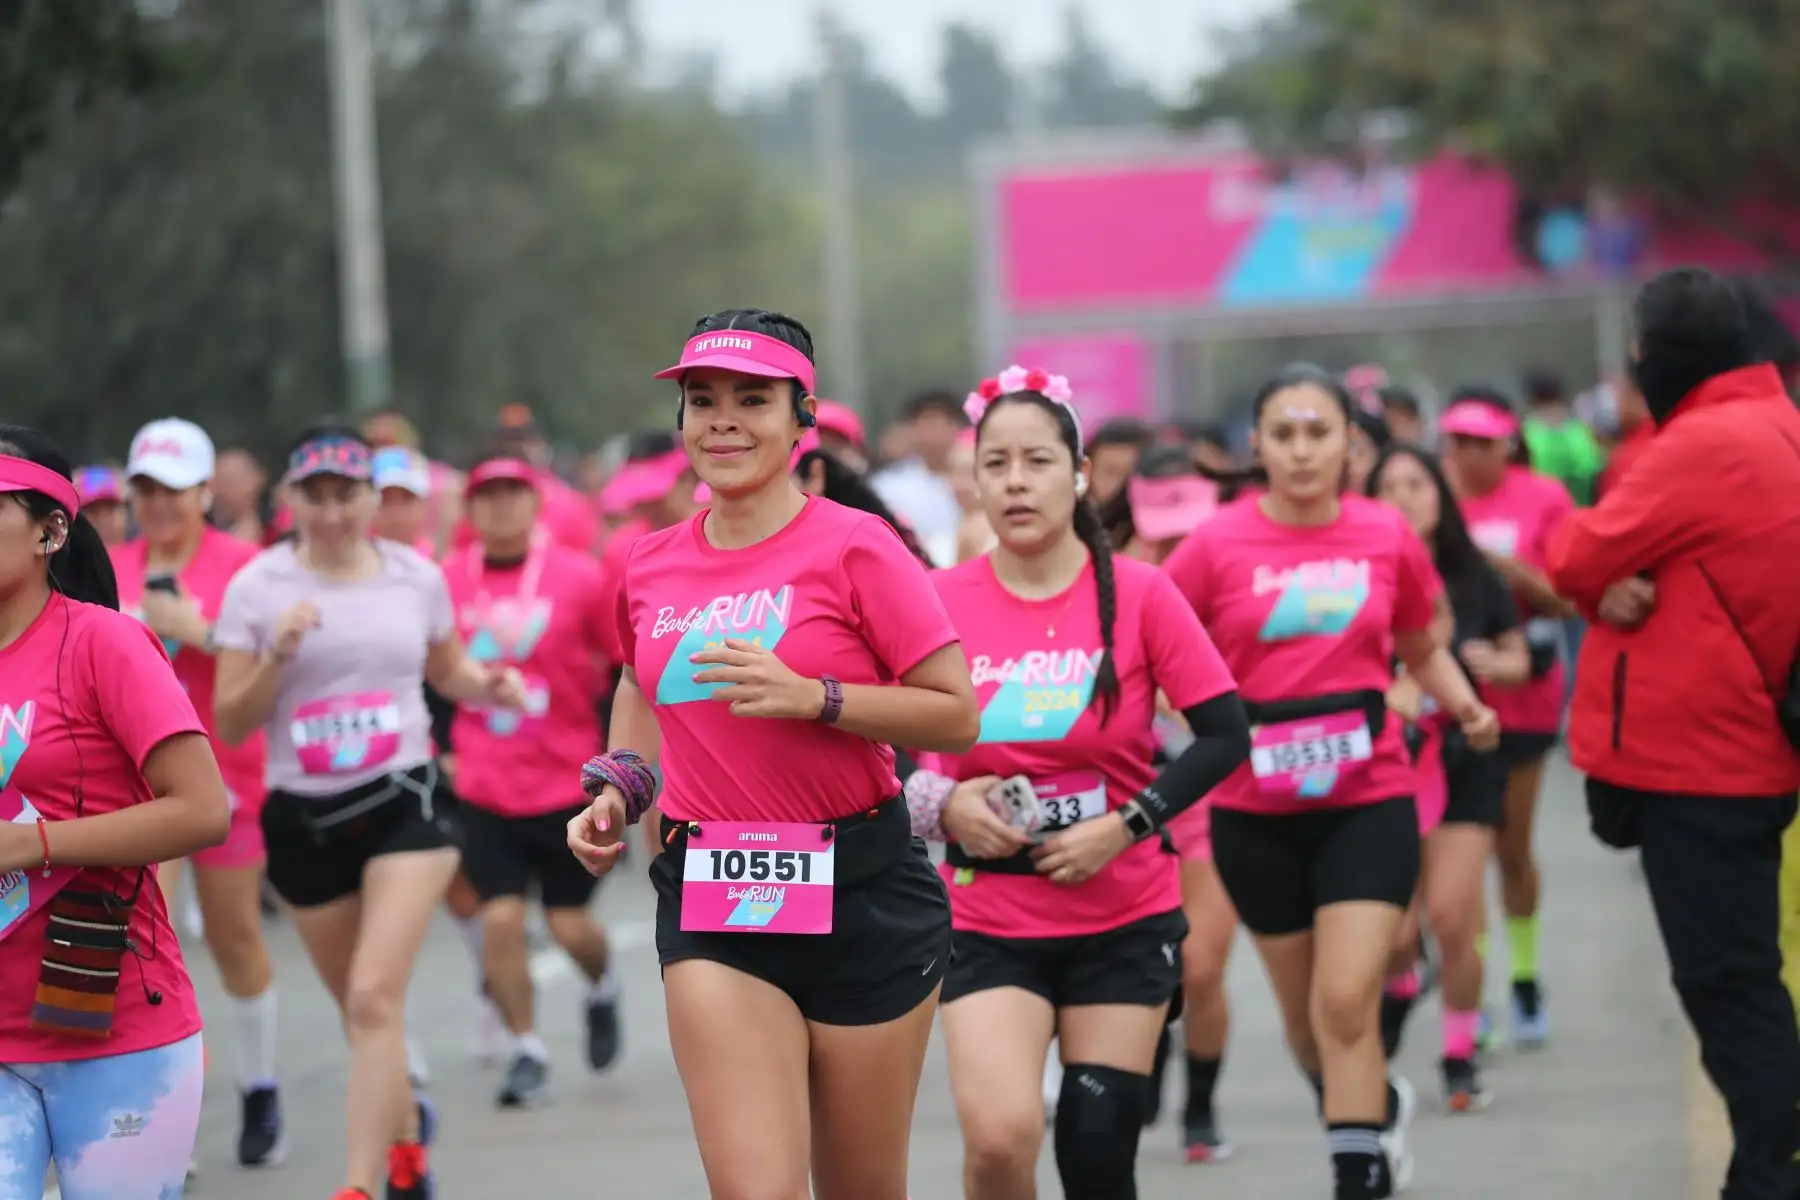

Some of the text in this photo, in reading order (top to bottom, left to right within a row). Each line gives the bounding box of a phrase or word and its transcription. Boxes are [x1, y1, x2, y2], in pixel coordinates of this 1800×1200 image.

[694, 336, 752, 352] aruma
[651, 584, 795, 639] Barbie RUN
[738, 832, 778, 842] aruma
[710, 850, 811, 882] 10551
[749, 885, 787, 903] RUN
